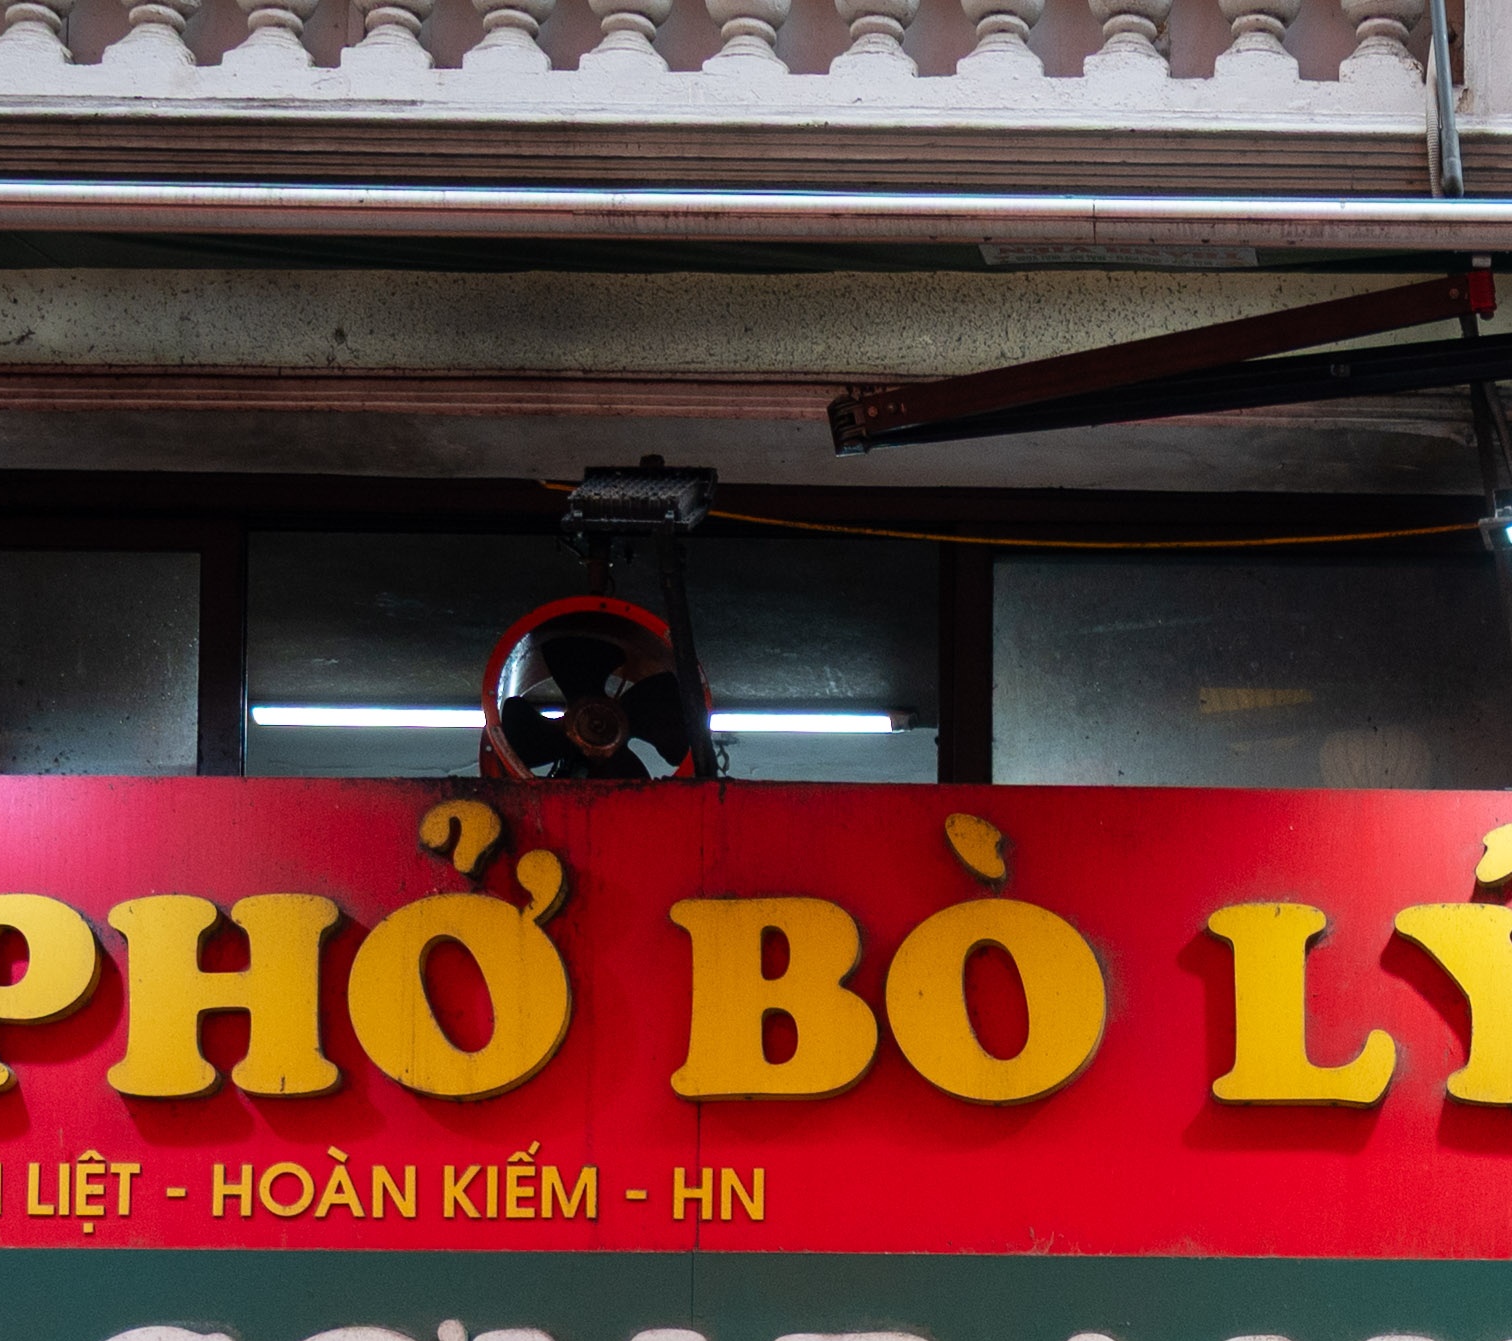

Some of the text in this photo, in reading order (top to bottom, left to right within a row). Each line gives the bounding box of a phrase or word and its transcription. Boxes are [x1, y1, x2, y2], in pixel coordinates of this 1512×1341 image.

[668, 812, 1110, 1108] BÒ
[25, 1147, 142, 1235] LIỆT
[210, 1144, 418, 1220] HOÀN
[442, 1139, 598, 1221] KIẾM
[672, 1165, 766, 1222] HN
